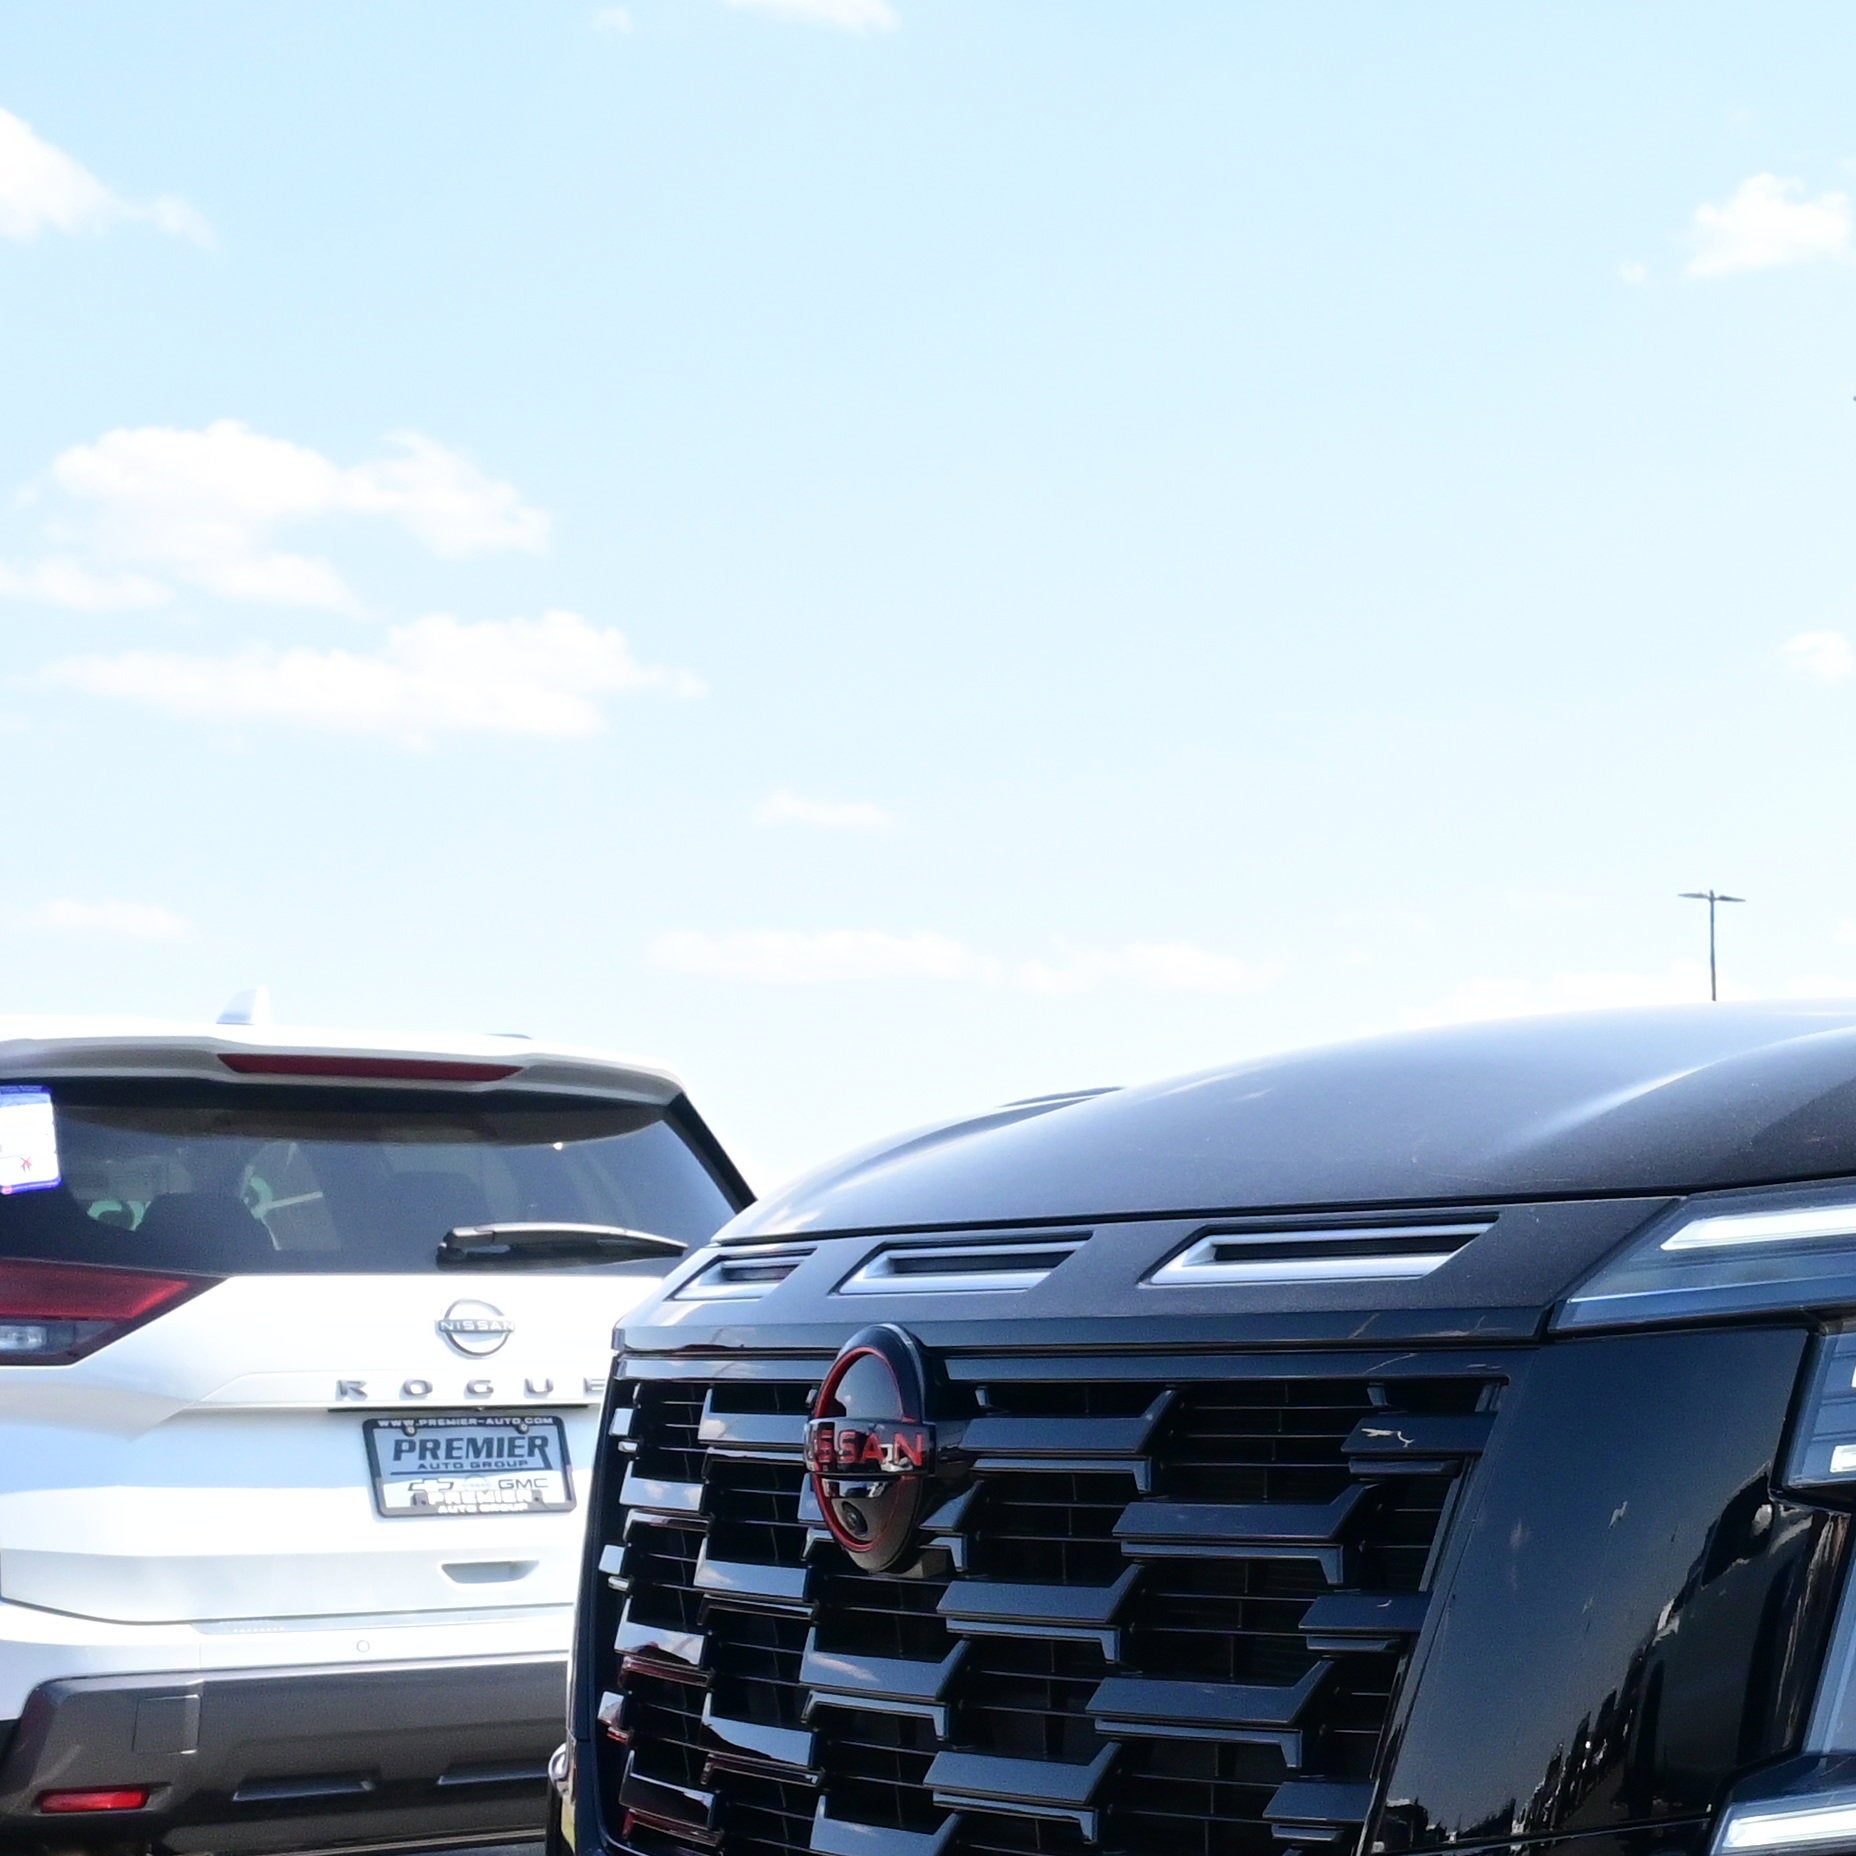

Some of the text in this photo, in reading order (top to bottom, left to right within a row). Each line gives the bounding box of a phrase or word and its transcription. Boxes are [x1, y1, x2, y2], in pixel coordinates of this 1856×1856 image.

[440, 1320, 515, 1331] NISSAN
[378, 1416, 554, 1428] WWW.PREMIER-AUTO.COM
[392, 1435, 553, 1470] PREMIER
[417, 1460, 529, 1470] AUTO GROUP
[498, 1478, 549, 1490] GMC
[428, 1490, 533, 1505] PREMIER
